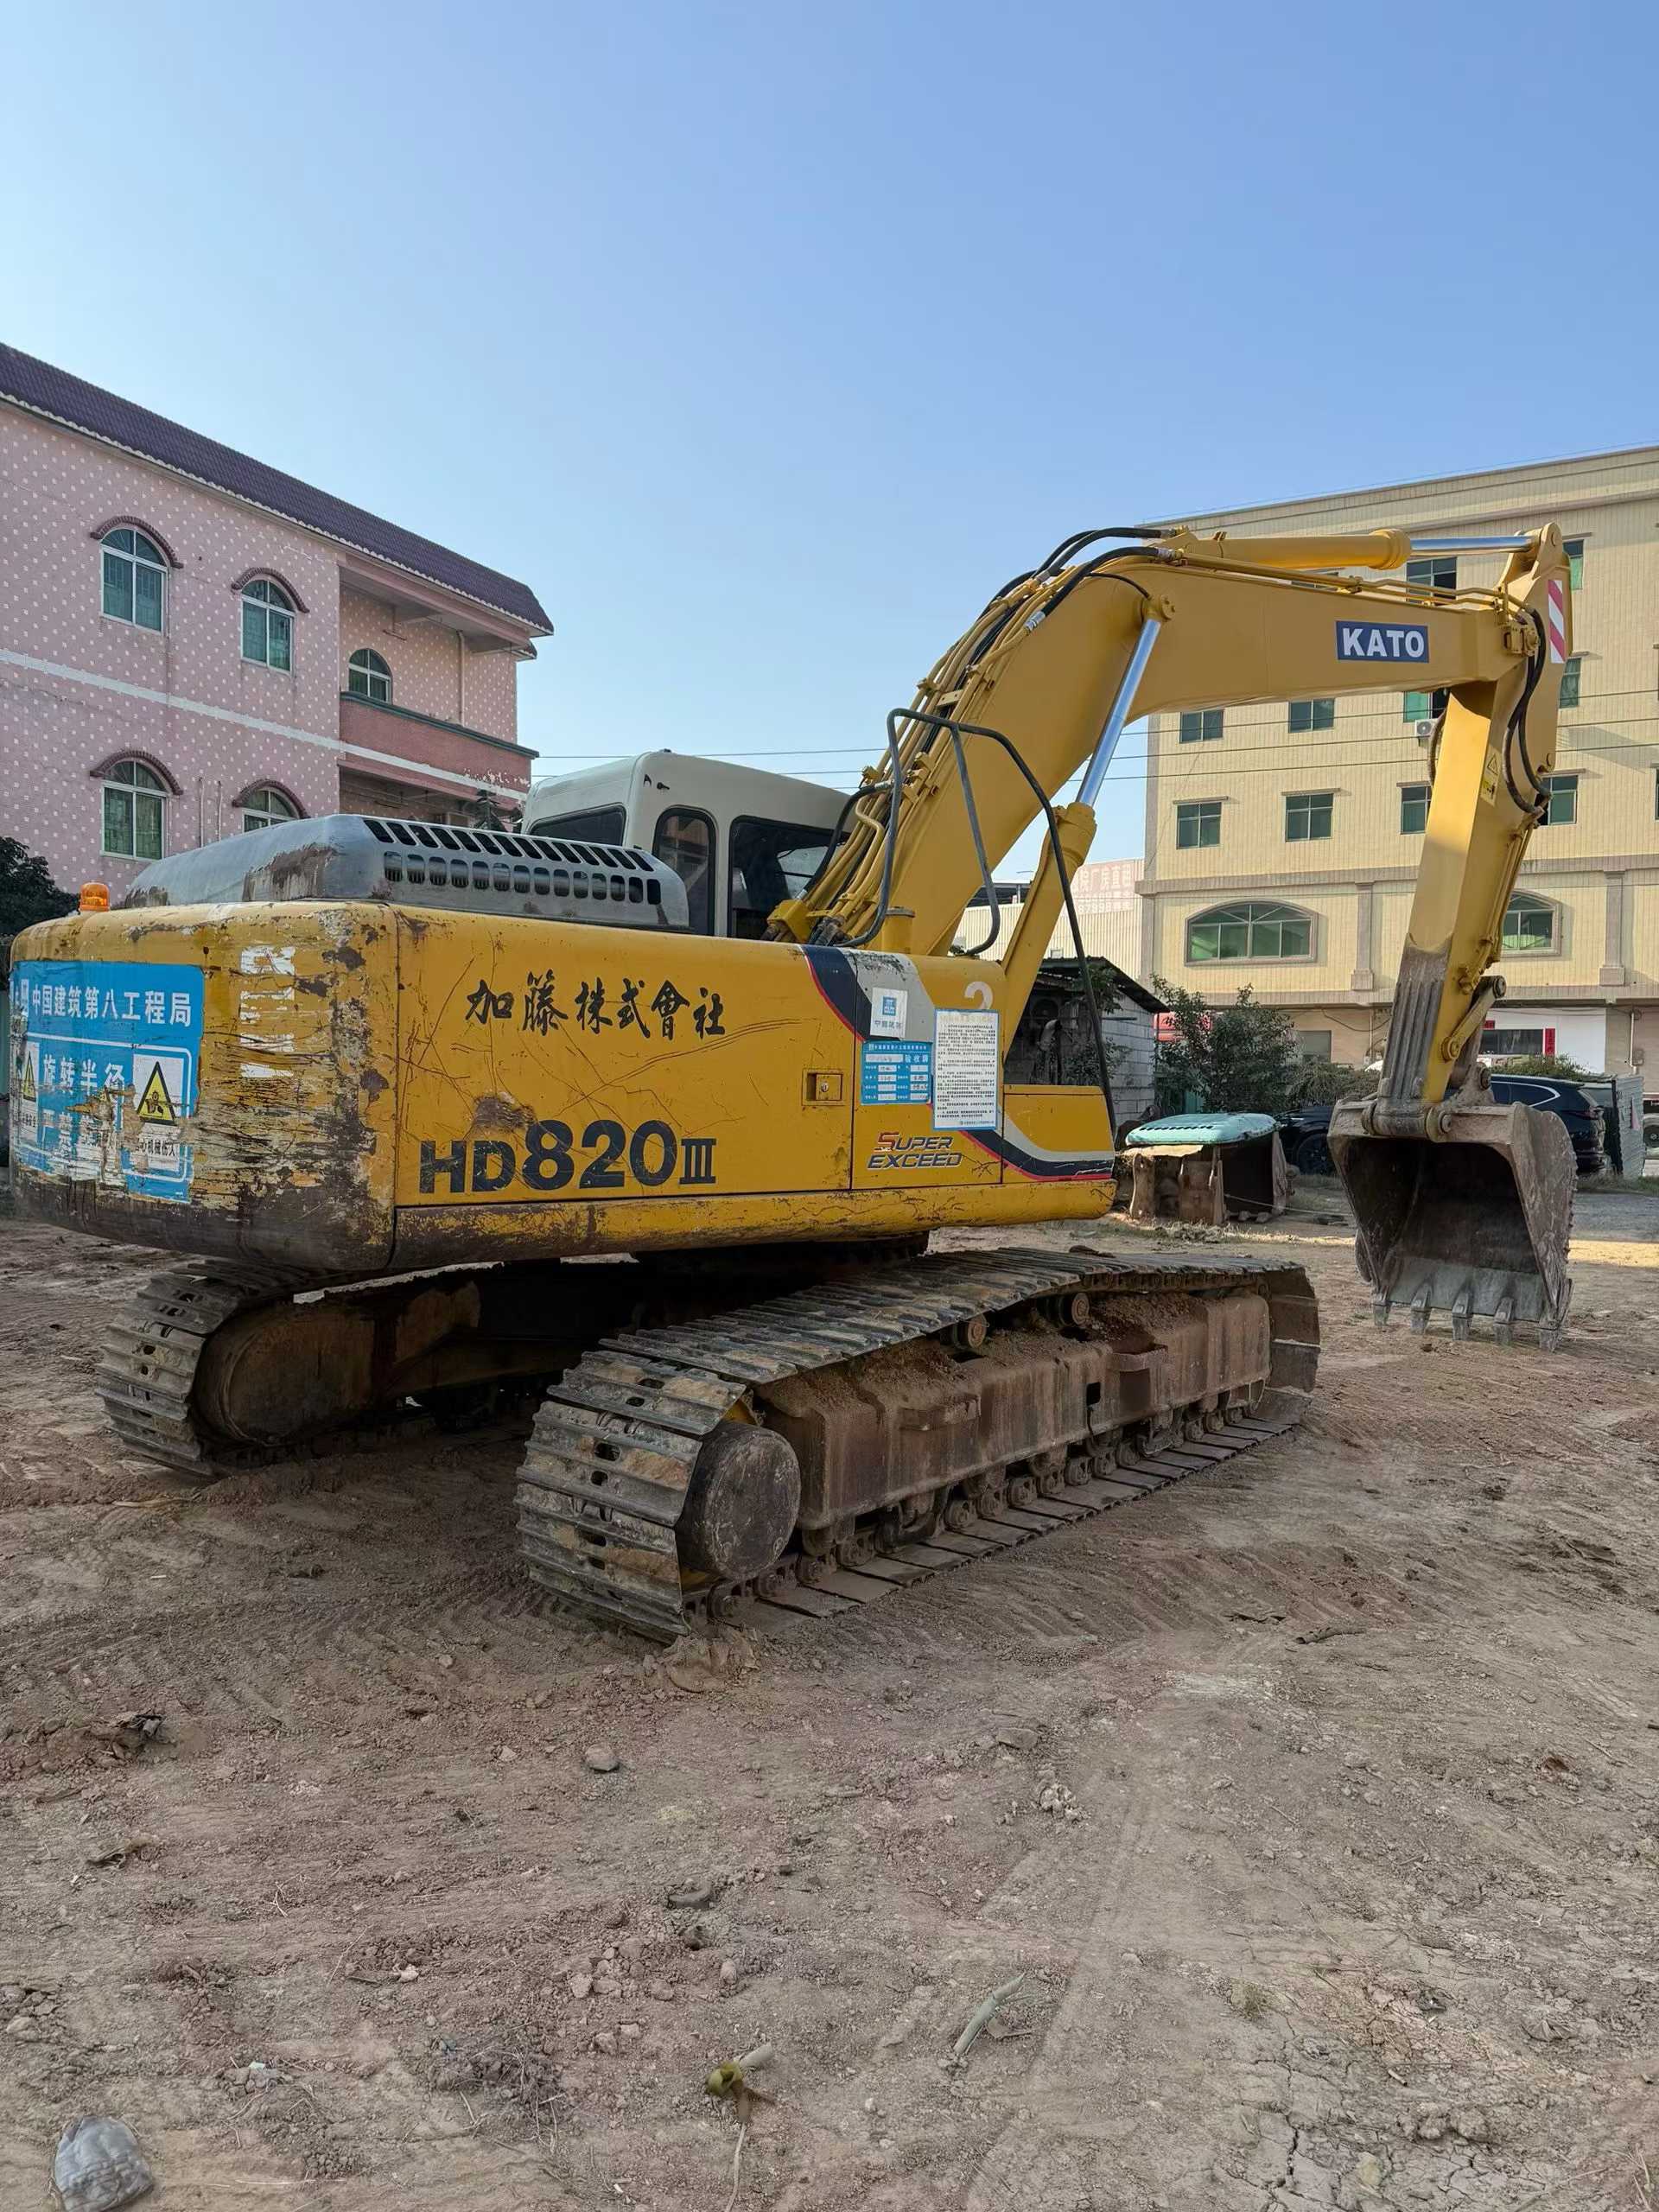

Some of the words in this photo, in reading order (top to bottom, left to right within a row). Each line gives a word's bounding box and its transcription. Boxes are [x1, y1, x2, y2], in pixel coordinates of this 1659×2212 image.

[1343, 627, 1425, 658] KATO
[32, 983, 191, 1027] 中国建筑第八工程局
[465, 969, 726, 1040] 加藤株式會社
[867, 1152, 965, 1170] EXCEED
